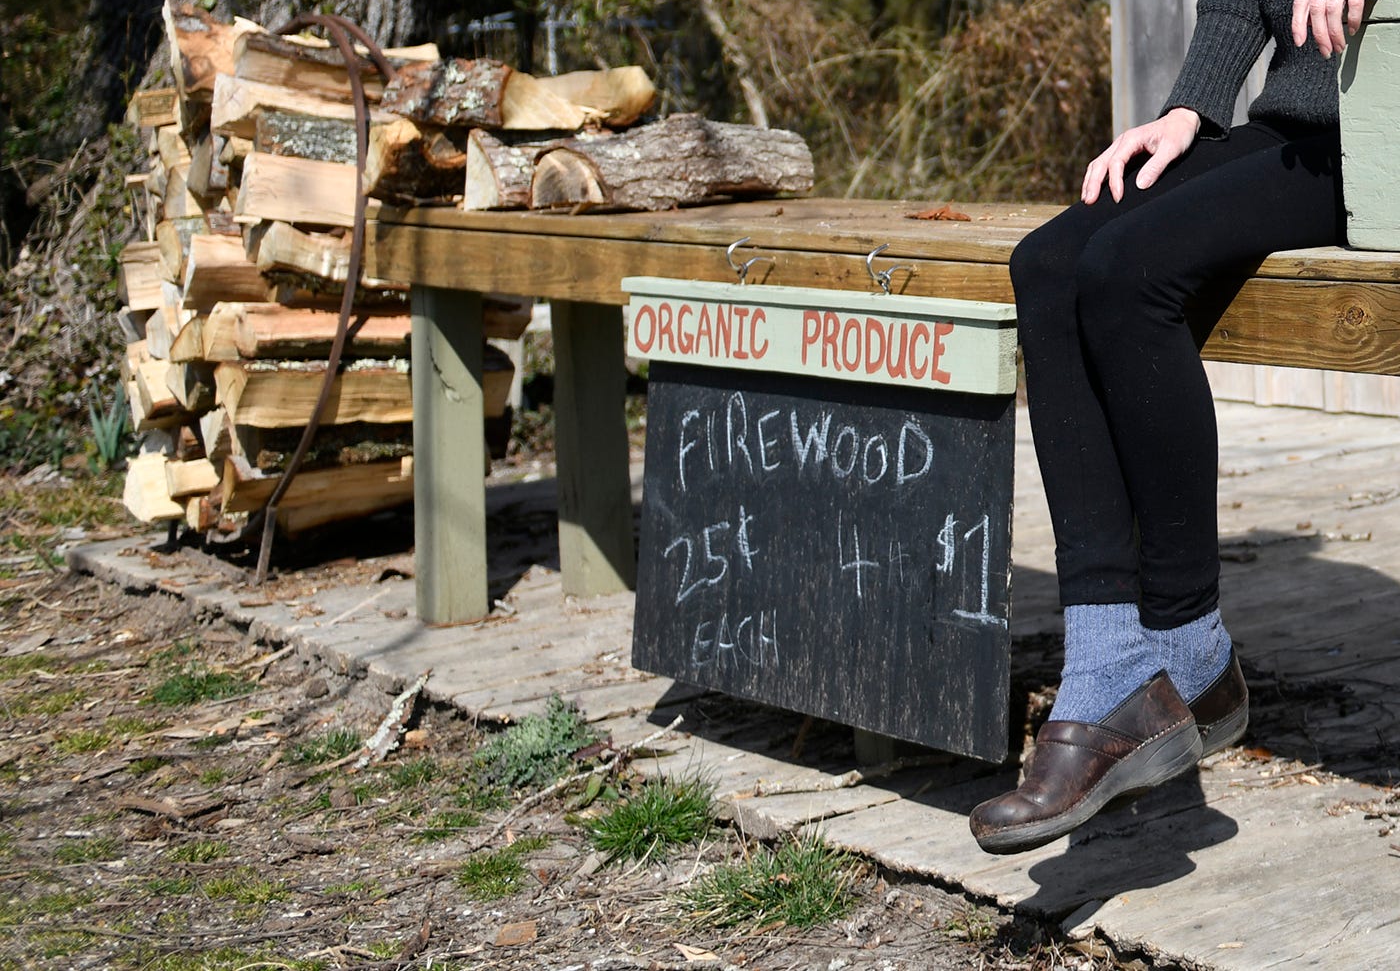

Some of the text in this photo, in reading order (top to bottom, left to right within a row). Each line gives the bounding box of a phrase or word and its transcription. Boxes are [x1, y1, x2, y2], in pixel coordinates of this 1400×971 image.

[633, 302, 954, 385] ORGANIC PRODUCE
[678, 390, 934, 492] FIREWOOD
[936, 512, 1008, 630] $1
[691, 608, 780, 670] EACH
